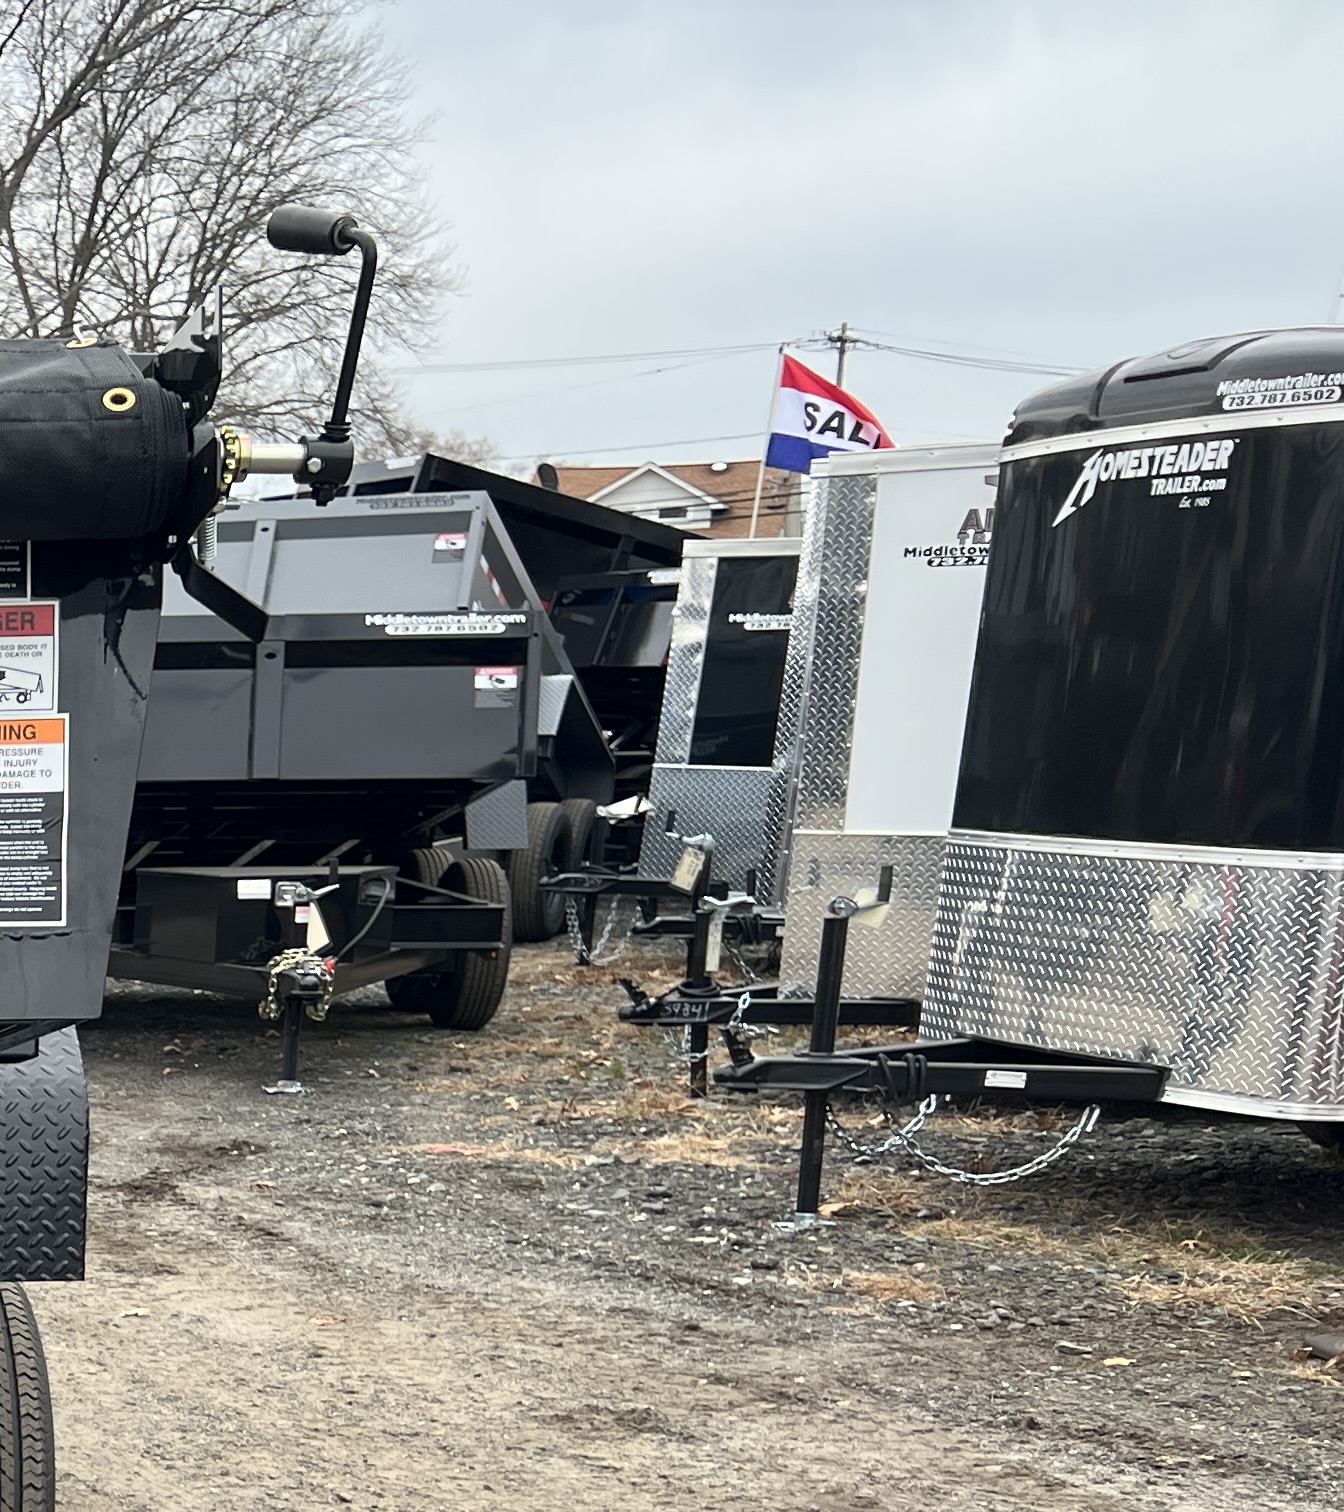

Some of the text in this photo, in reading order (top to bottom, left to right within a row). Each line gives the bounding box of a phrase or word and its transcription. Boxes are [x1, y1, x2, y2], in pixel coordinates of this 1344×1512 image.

[1228, 389, 1335, 407] 732.787.6502
[804, 402, 881, 449] SAL
[1052, 440, 1235, 527] HOMESTEADER
[1150, 475, 1227, 496] TRAILER.com
[4, 759, 38, 767] INJURY
[40, 769, 52, 777] TO
